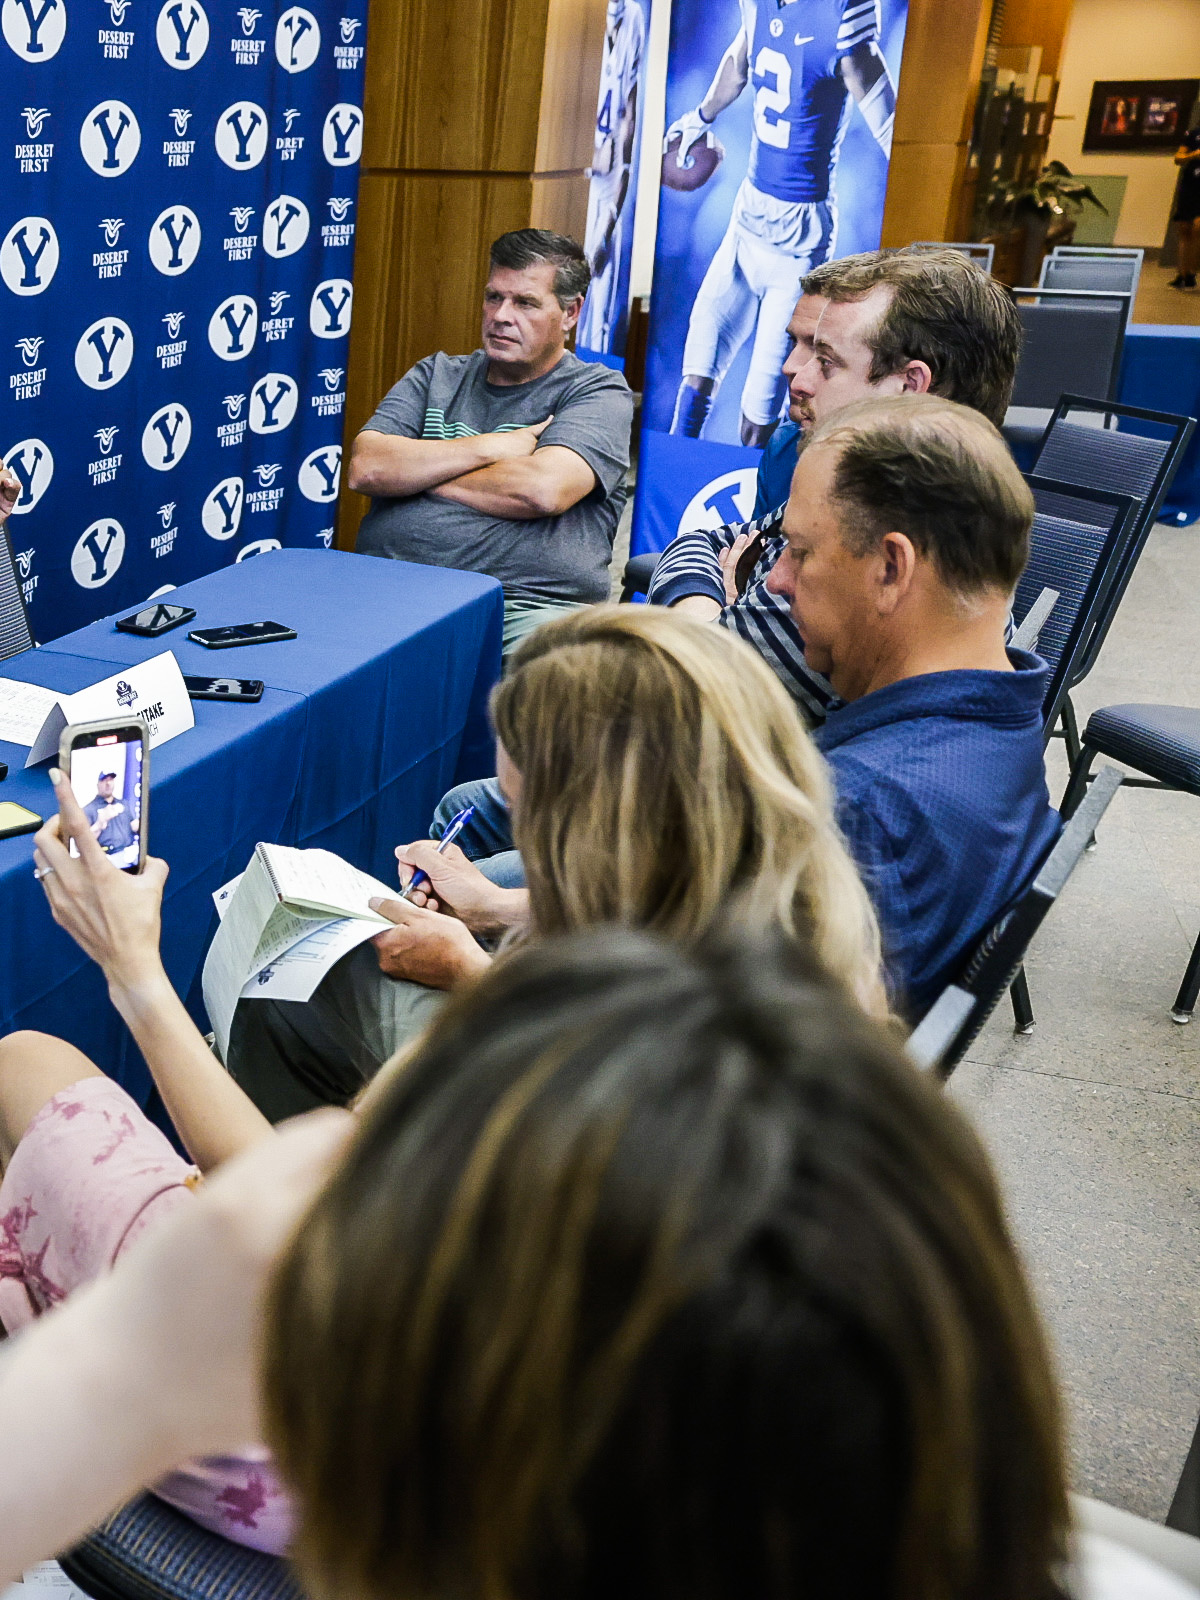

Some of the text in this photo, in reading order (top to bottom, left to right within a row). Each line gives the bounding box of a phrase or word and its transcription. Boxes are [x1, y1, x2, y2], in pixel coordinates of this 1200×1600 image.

[98, 30, 134, 45] DESERET
[104, 45, 129, 59] FIRST
[231, 39, 266, 53] DESERET
[236, 52, 259, 65] FIRST
[753, 46, 792, 149] 2
[15, 144, 54, 158] DESERET
[163, 141, 195, 154] DESERET
[20, 159, 49, 173] FIRST
[168, 154, 190, 167] FIRST
[224, 236, 258, 250] DESERET
[324, 235, 350, 247] FIRST
[93, 250, 129, 266] DESERET
[228, 248, 253, 261] FIRST
[99, 264, 122, 279] FIRST
[156, 340, 187, 358] DESERET
[161, 354, 182, 369] FIRST
[10, 368, 47, 388] DESERET
[16, 383, 42, 400] FIRST
[318, 404, 342, 416] FIRST
[217, 420, 247, 438] DESERET
[221, 432, 243, 447] FIRST
[88, 454, 122, 476] DESERET
[93, 468, 117, 486] FIRST
[150, 527, 178, 549] DESERET
[155, 541, 173, 559] FIRST
